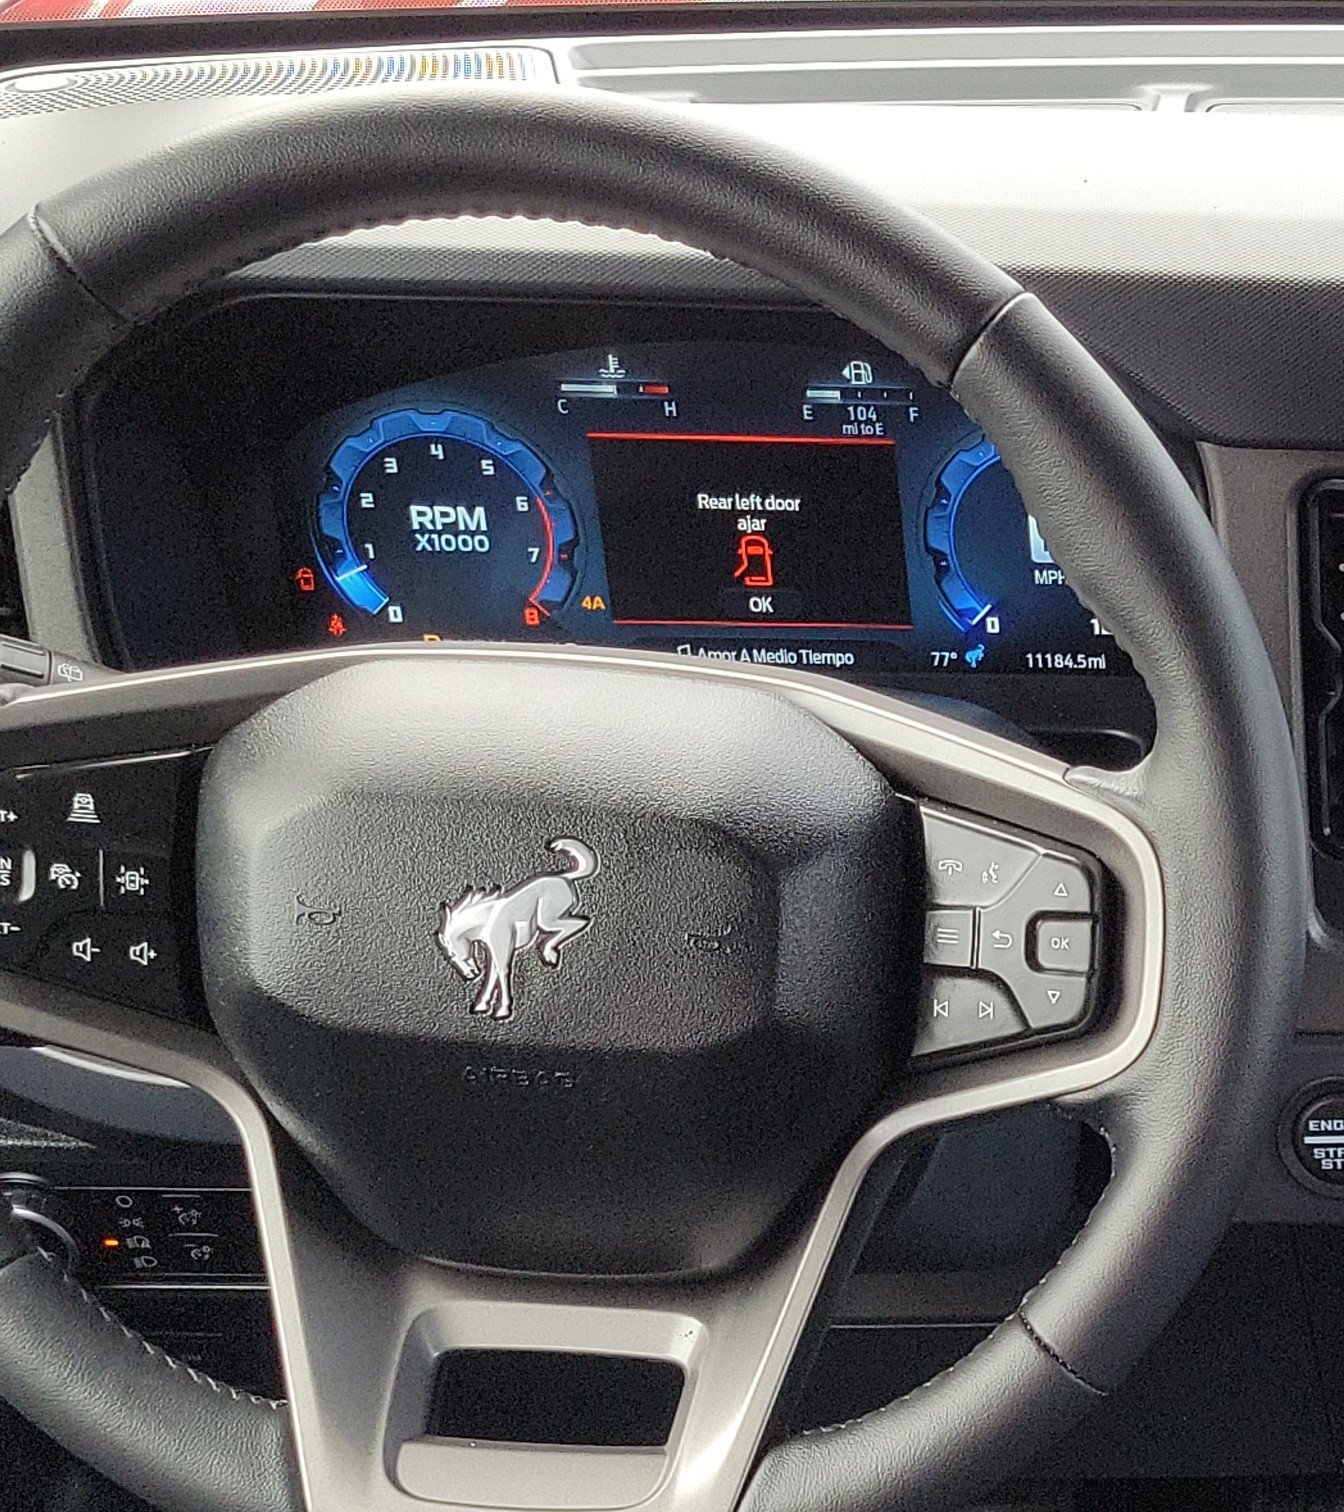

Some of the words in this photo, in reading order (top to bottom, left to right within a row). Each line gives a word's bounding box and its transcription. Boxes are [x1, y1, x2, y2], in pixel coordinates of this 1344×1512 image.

[558, 400, 568, 414] C
[665, 403, 676, 417] H
[803, 407, 813, 420] E
[847, 406, 877, 421] 104
[910, 408, 919, 422] F
[860, 422, 872, 434] to
[875, 423, 884, 435] E
[430, 444, 444, 460] 4
[384, 457, 398, 473] 3
[481, 460, 495, 475] 5
[360, 493, 374, 508] 2
[516, 497, 528, 512] 6
[698, 493, 732, 511] Rear
[736, 496, 762, 511] left
[765, 495, 800, 511] door
[410, 505, 488, 531] RPM
[737, 518, 767, 533] ajar
[415, 533, 490, 552] X1000
[365, 543, 375, 559] 1
[528, 548, 540, 563] 7
[582, 596, 605, 610] 4A
[749, 598, 774, 613] OK
[389, 606, 403, 622] 0
[740, 648, 751, 663] A
[753, 647, 797, 664] Medio
[800, 649, 854, 668] Tiempo
[1051, 937, 1070, 949] OK
